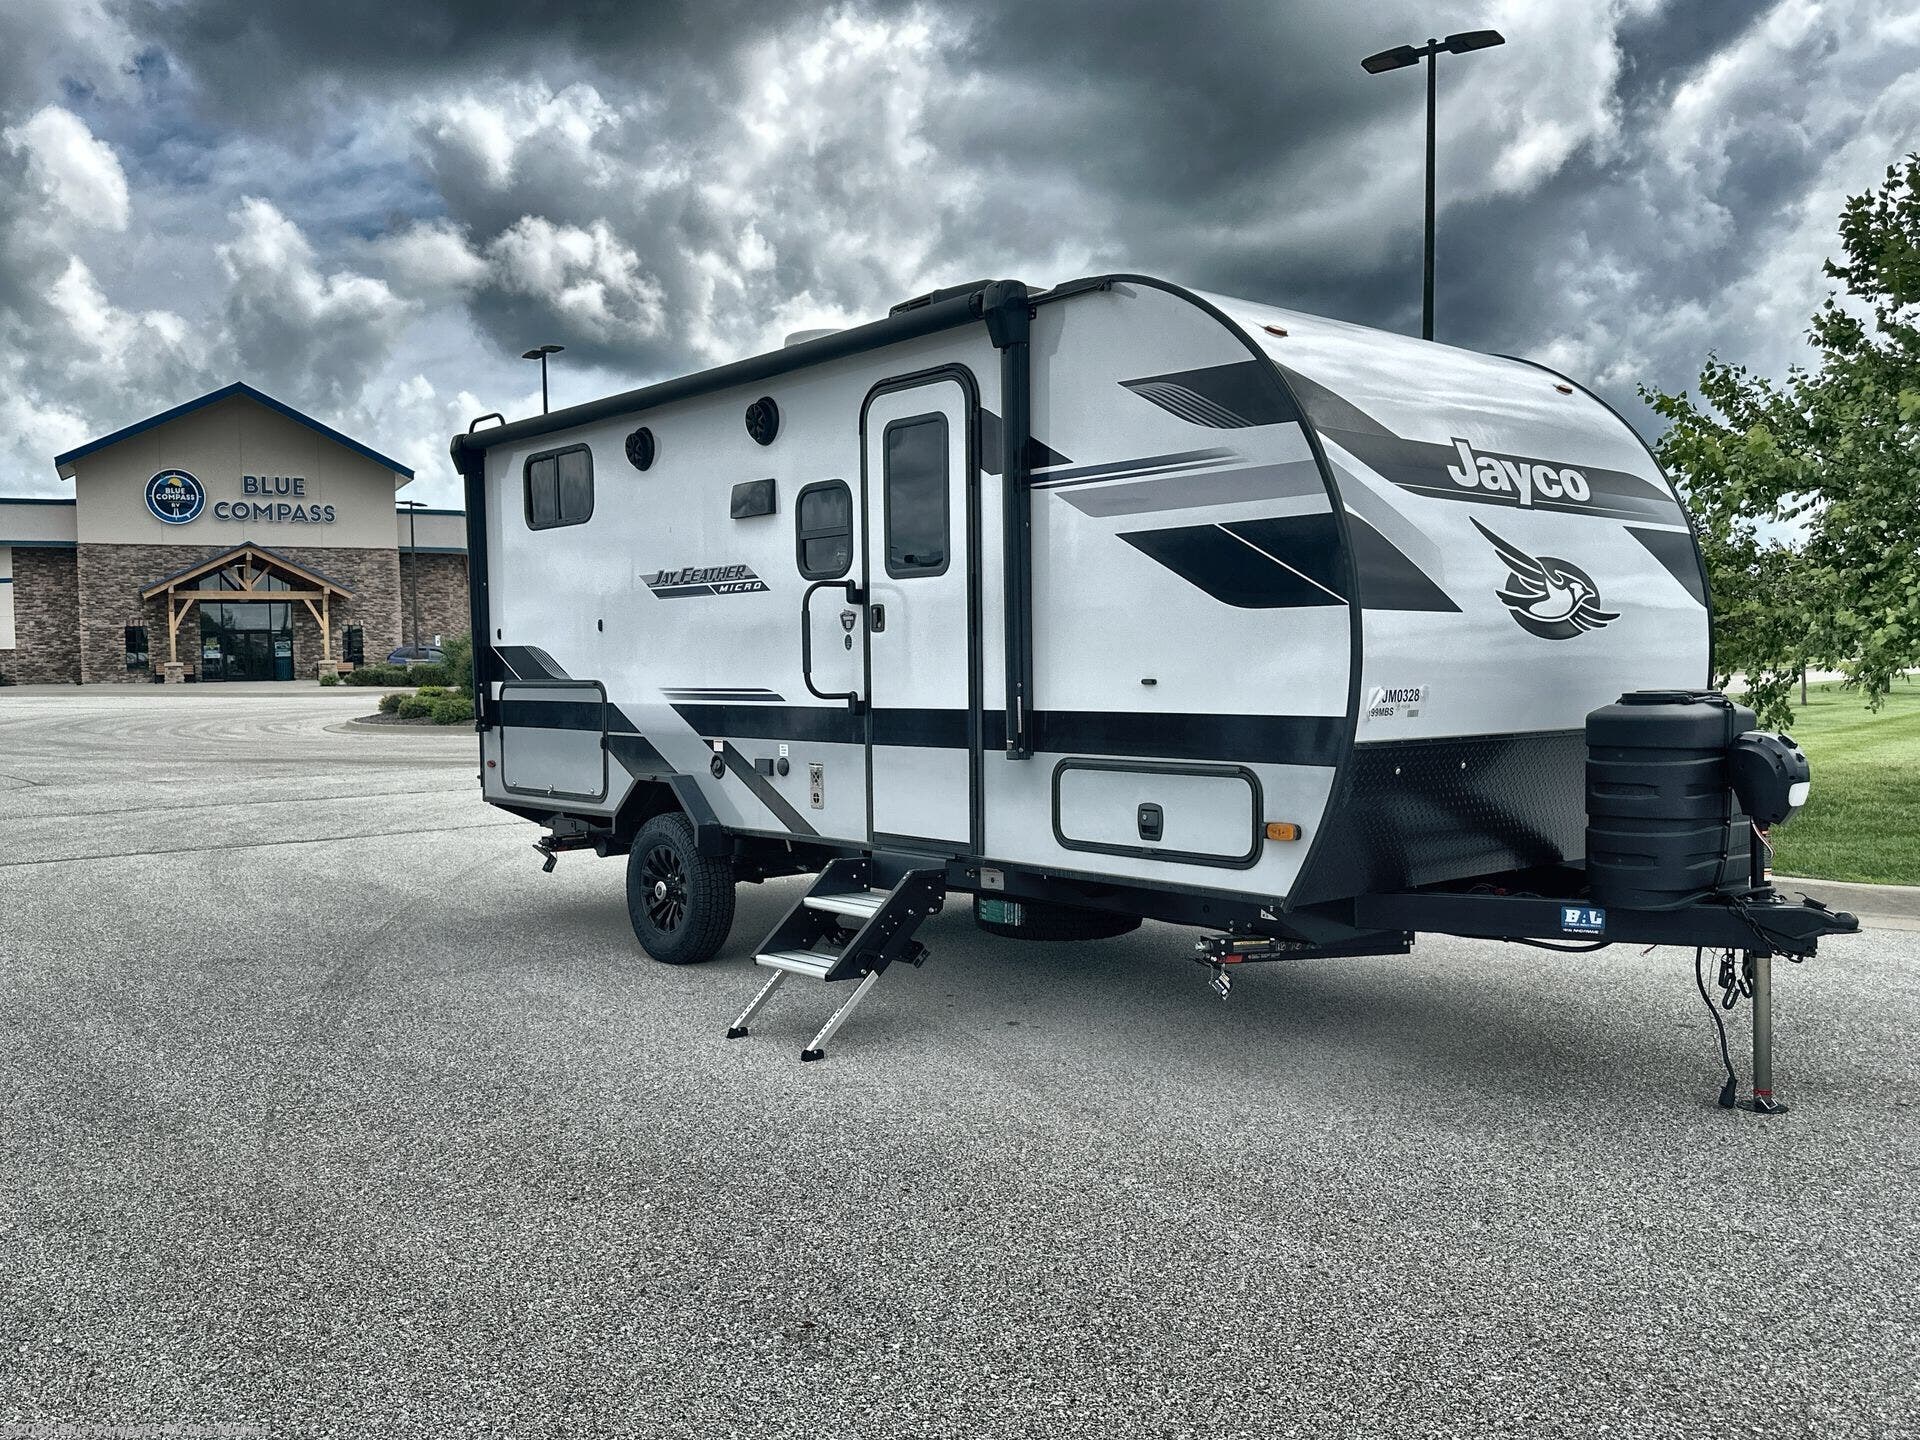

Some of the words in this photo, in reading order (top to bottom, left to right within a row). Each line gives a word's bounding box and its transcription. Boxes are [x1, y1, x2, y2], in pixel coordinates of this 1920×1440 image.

[1447, 440, 1591, 506] Jayco
[242, 475, 306, 496] BLUE
[156, 493, 195, 501] COMPASS
[213, 501, 337, 524] COMPASS
[719, 582, 762, 593] MICRO
